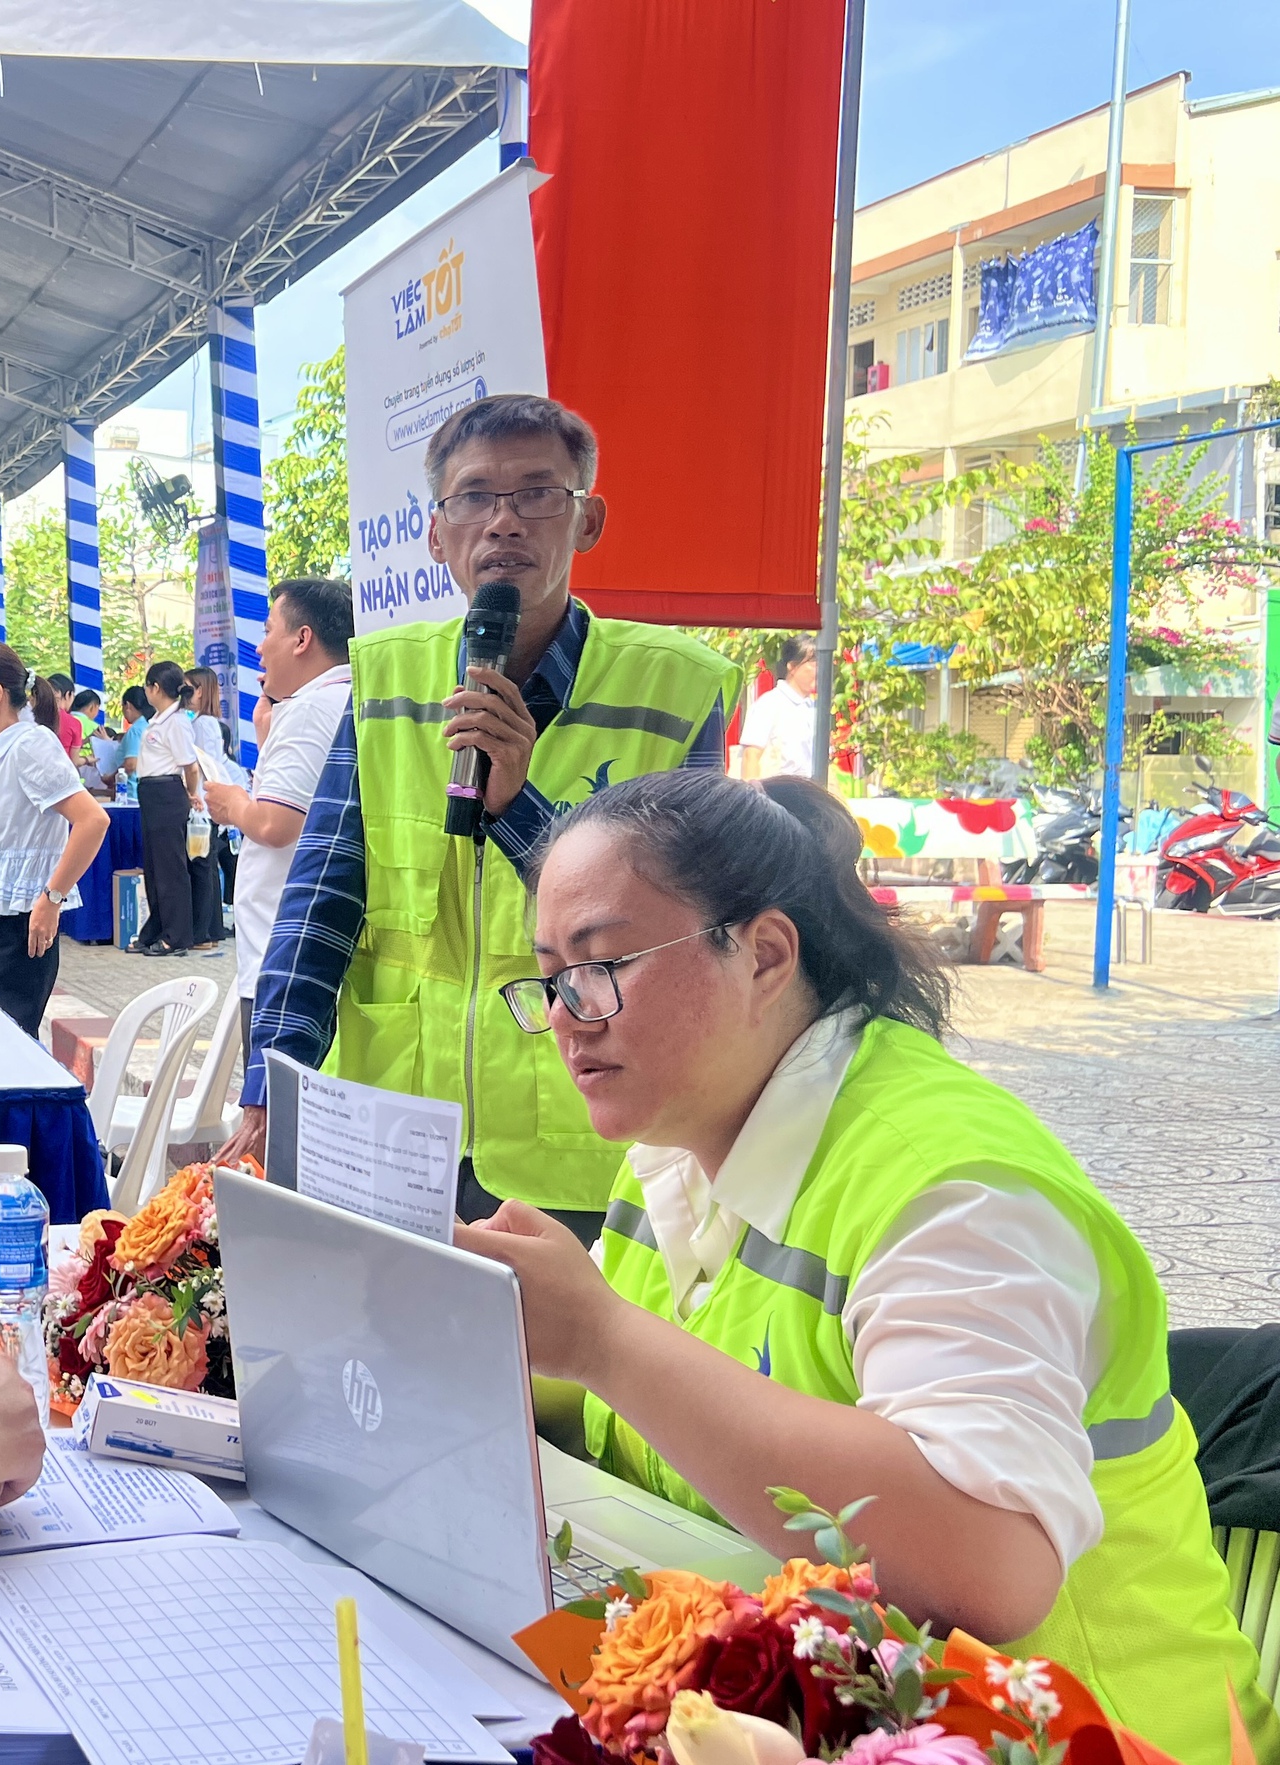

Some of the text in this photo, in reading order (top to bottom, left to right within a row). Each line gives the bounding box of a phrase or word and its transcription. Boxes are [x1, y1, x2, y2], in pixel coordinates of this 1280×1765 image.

[421, 236, 464, 323] TỐT
[384, 390, 404, 409] Chuyên
[404, 384, 420, 400] trang
[420, 372, 434, 394] tuyển
[435, 369, 452, 387] dụng
[452, 361, 460, 377] số
[475, 350, 485, 365] lớn
[394, 397, 472, 441] www.vieclamtotcom
[359, 513, 391, 561] TẠO
[396, 489, 423, 543] HỒ
[360, 565, 409, 618] NHẬN
[342, 1359, 382, 1432] hp
